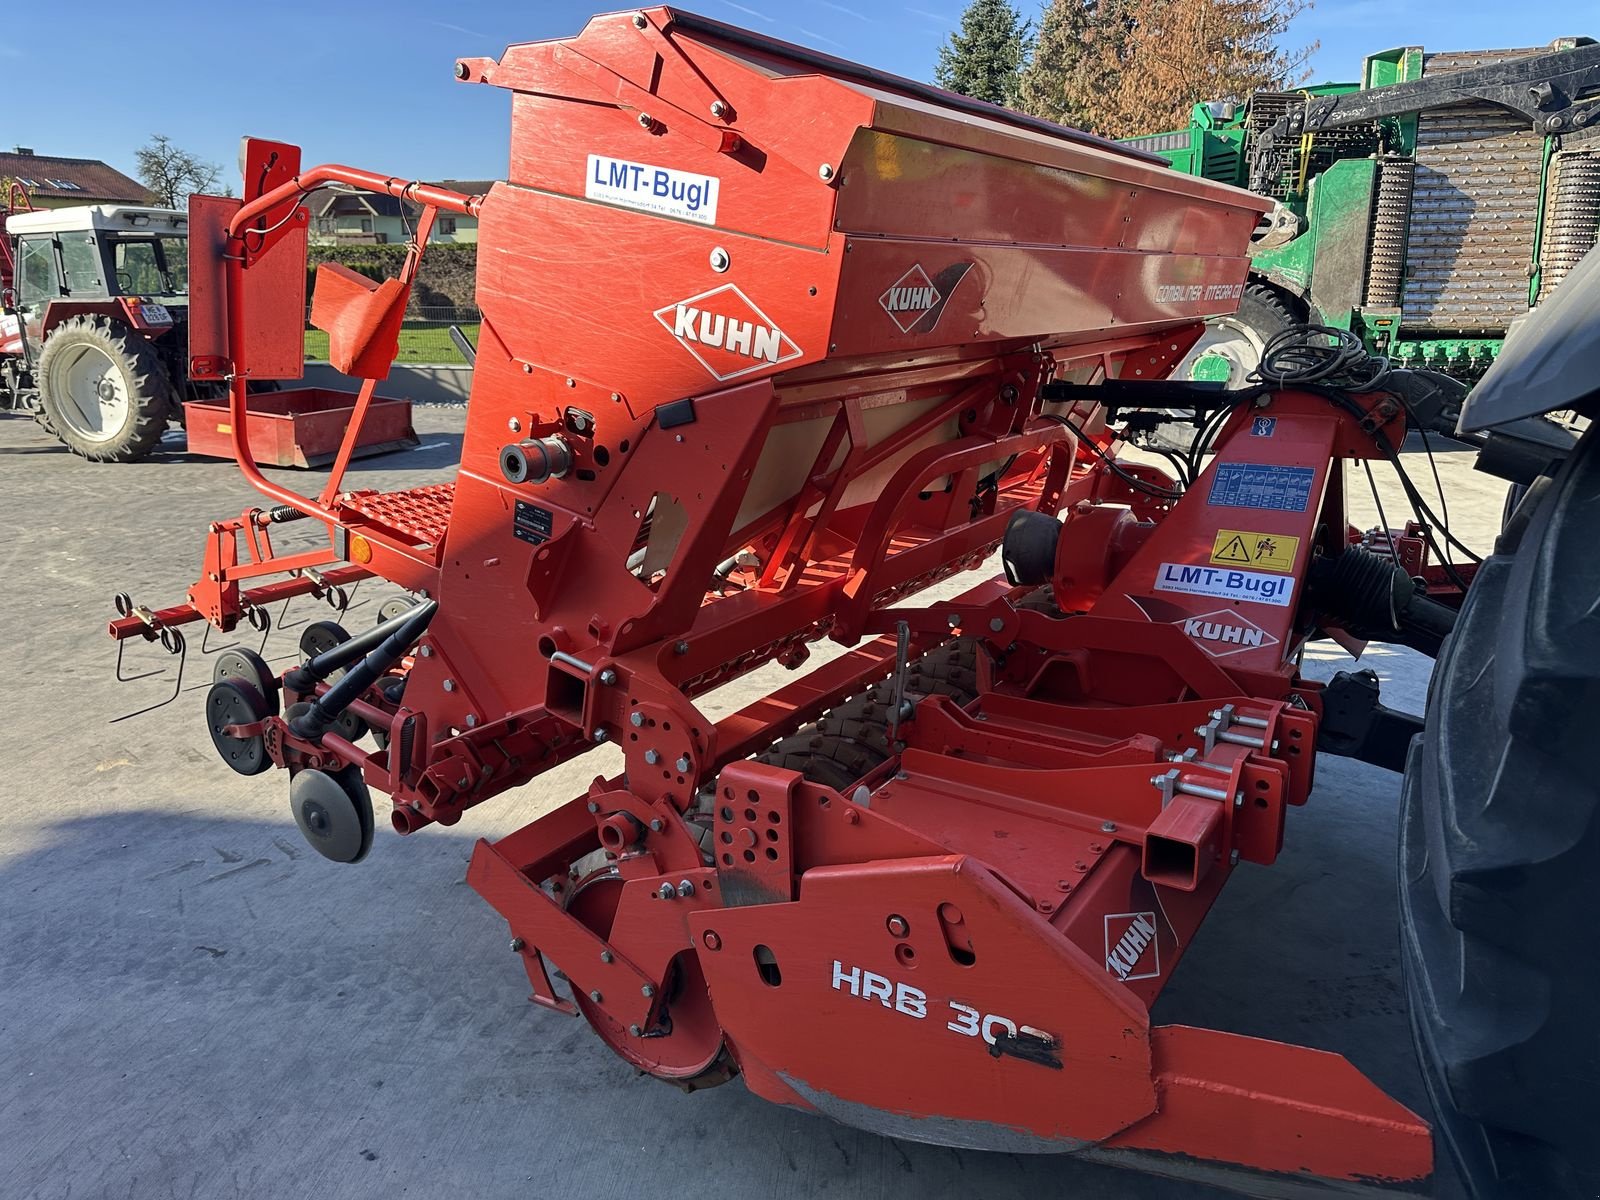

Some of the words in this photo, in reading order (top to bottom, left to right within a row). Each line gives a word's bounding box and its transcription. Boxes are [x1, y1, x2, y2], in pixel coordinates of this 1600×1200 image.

[594, 160, 710, 211] LMT-Bugl
[887, 287, 934, 312] KUHN
[674, 304, 782, 363] KUHN
[1164, 565, 1286, 598] LMT-Bugl
[1183, 620, 1265, 646] KUHN
[1106, 914, 1156, 980] KUHN
[832, 960, 928, 1019] HRB
